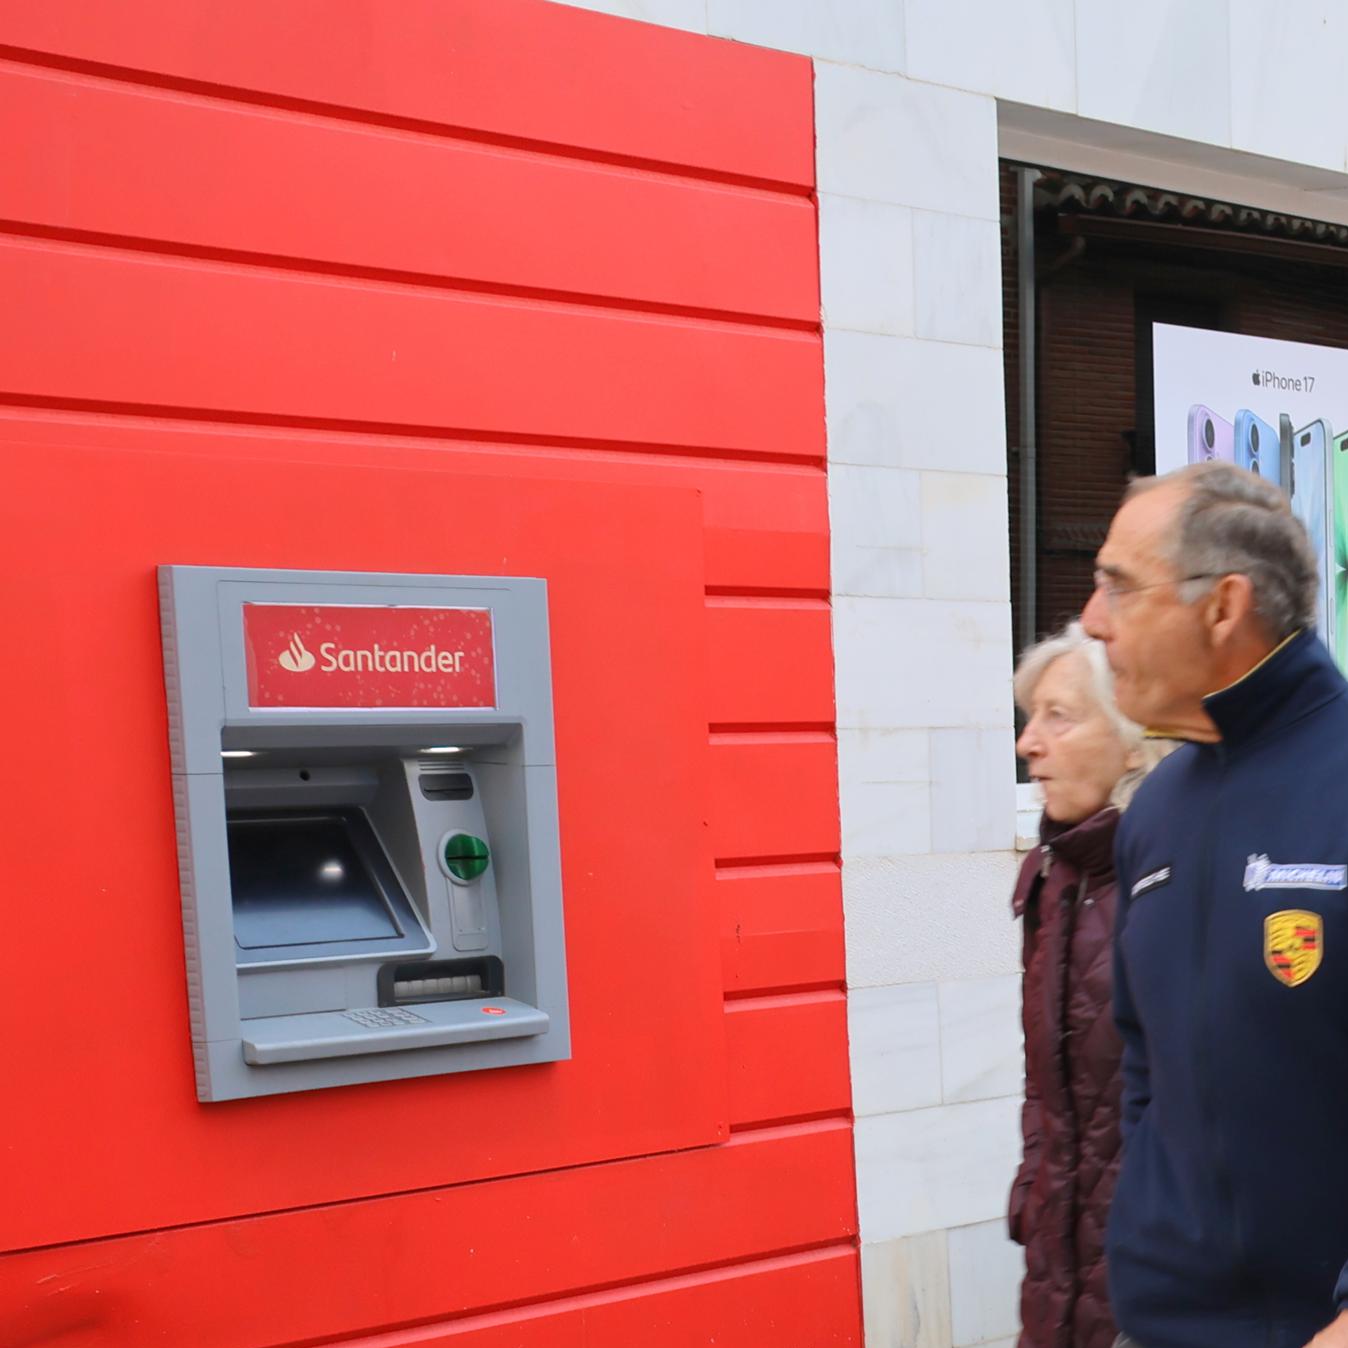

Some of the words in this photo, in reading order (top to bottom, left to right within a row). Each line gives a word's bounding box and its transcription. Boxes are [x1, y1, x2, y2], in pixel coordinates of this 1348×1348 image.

[1262, 370, 1302, 392] iPhone
[1303, 376, 1315, 393] 17
[320, 641, 465, 674] Santander
